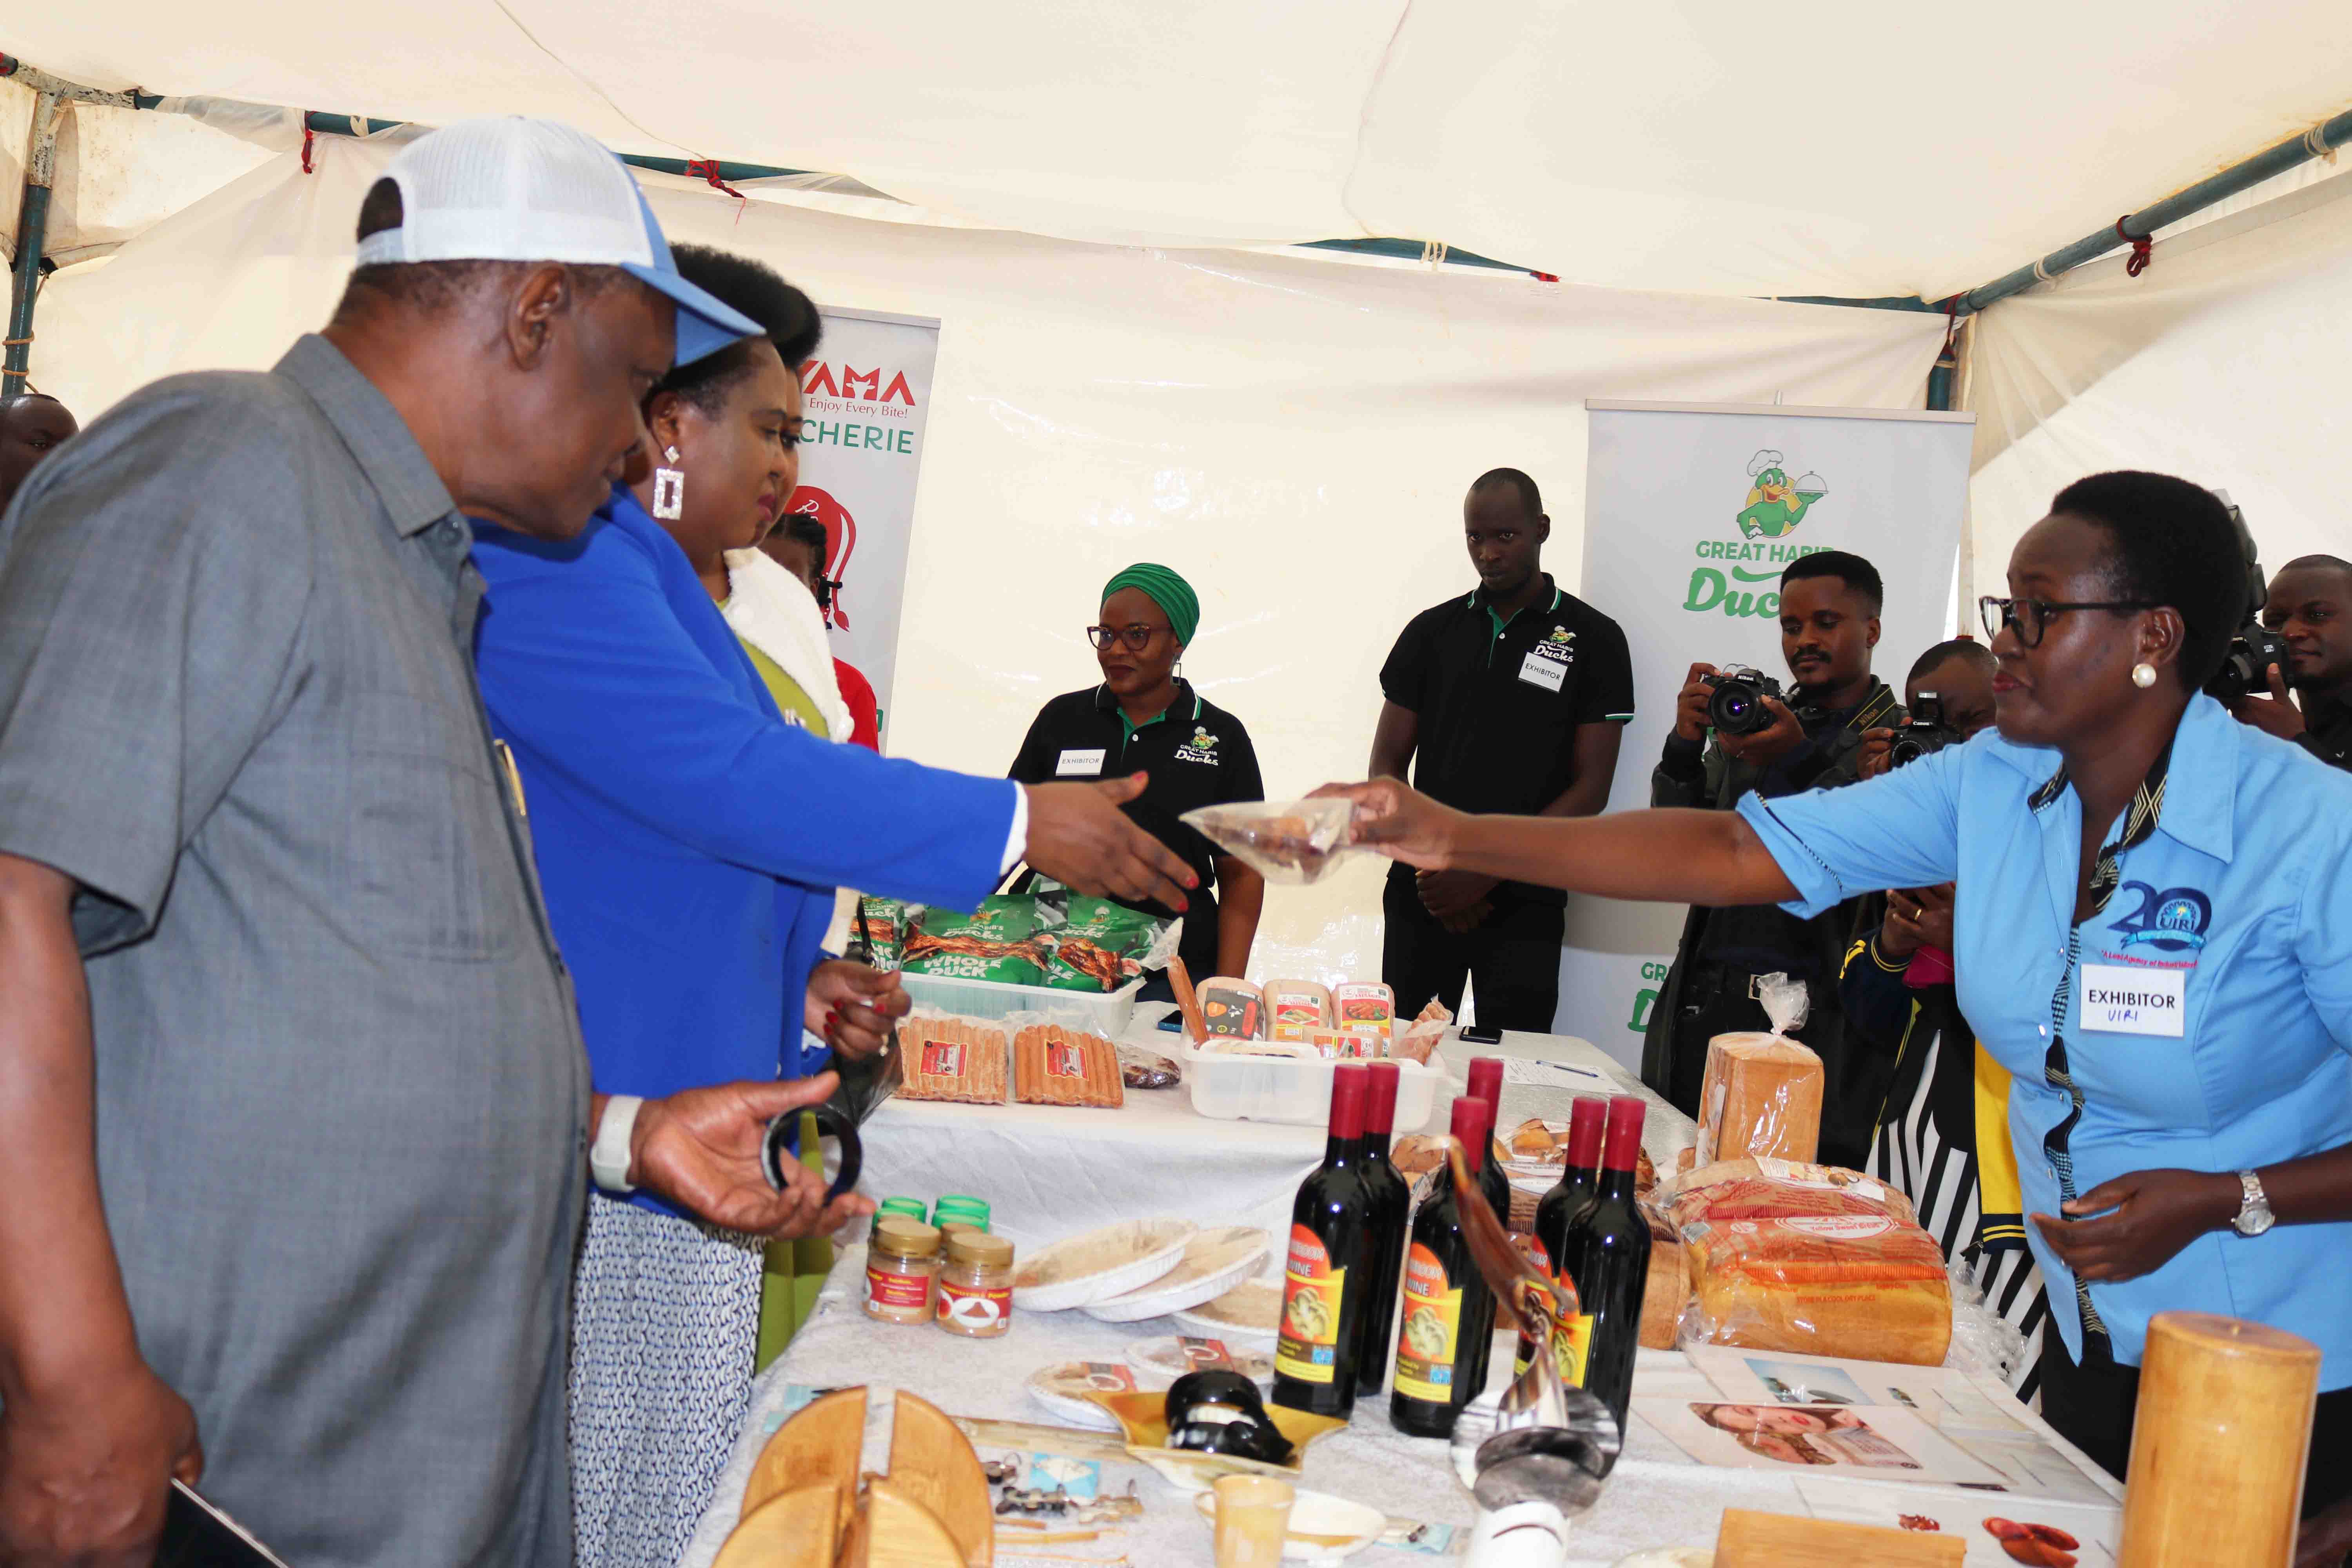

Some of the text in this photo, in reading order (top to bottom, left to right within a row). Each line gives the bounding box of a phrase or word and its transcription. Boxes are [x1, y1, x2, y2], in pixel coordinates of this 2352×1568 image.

[809, 398, 908, 419] Enjoy Every Bite!
[1695, 540, 1766, 561] GREAT
[1533, 645, 1574, 662] Ducks
[1525, 663, 1561, 680] EXHIBITOR
[1180, 744, 1199, 753] GREAT
[1174, 749, 1219, 766] Ducks
[2160, 917, 2196, 934] UIRI
[924, 955, 1003, 969] WHOLE
[927, 966, 987, 978] DUCK
[2088, 989, 2176, 1009] EXHIBITOR
[2107, 1009, 2138, 1022] UIRI
